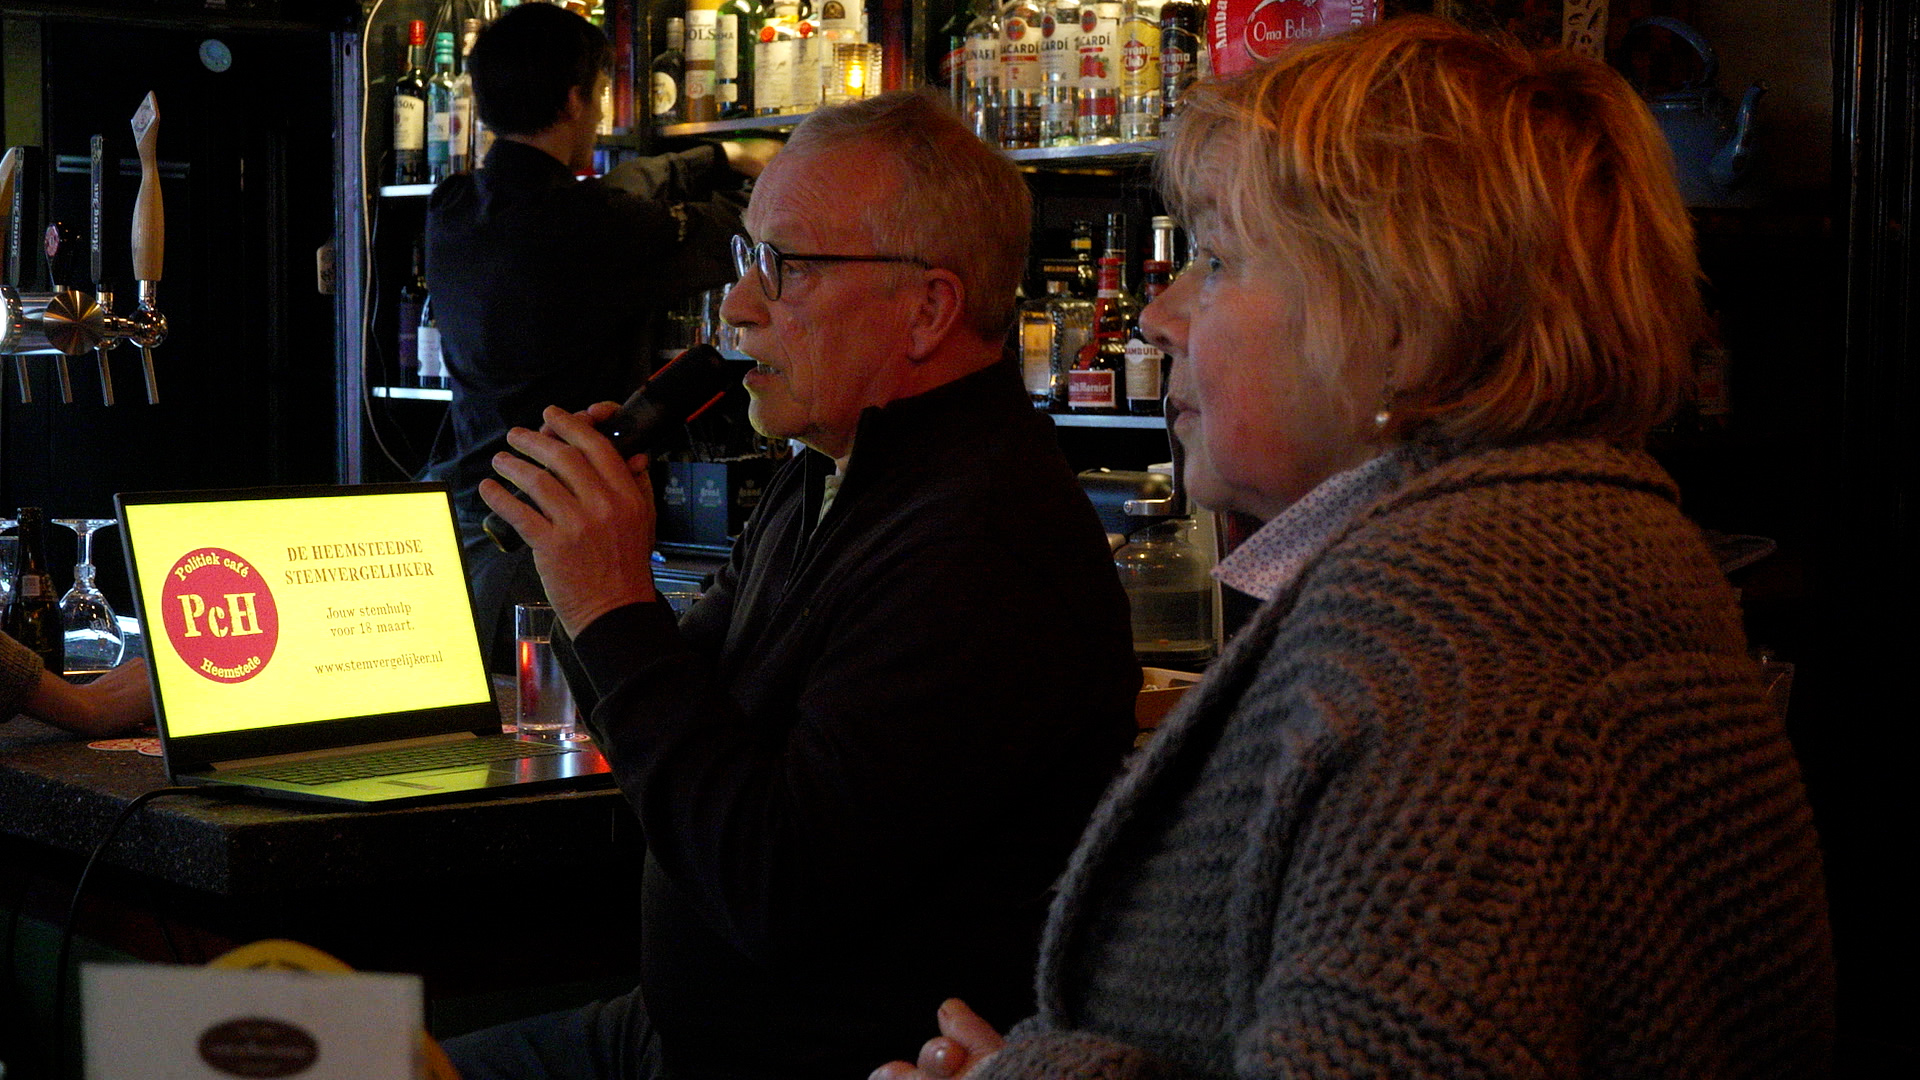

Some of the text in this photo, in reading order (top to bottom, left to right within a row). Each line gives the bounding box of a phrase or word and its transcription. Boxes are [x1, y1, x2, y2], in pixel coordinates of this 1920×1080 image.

[688, 28, 717, 41] OLS
[1253, 21, 1282, 42] Oma
[287, 539, 424, 562] DE HEEMSTEEDSE
[174, 551, 250, 582] Politiek café
[285, 561, 435, 586] STEMVERGELIJKER
[176, 592, 263, 639] PcH
[325, 601, 412, 621] Jouw stemhulp
[329, 617, 416, 637] voor 18 maart.
[200, 654, 262, 679] Heemstede
[314, 650, 444, 675] www.stemvergelijker.nl
